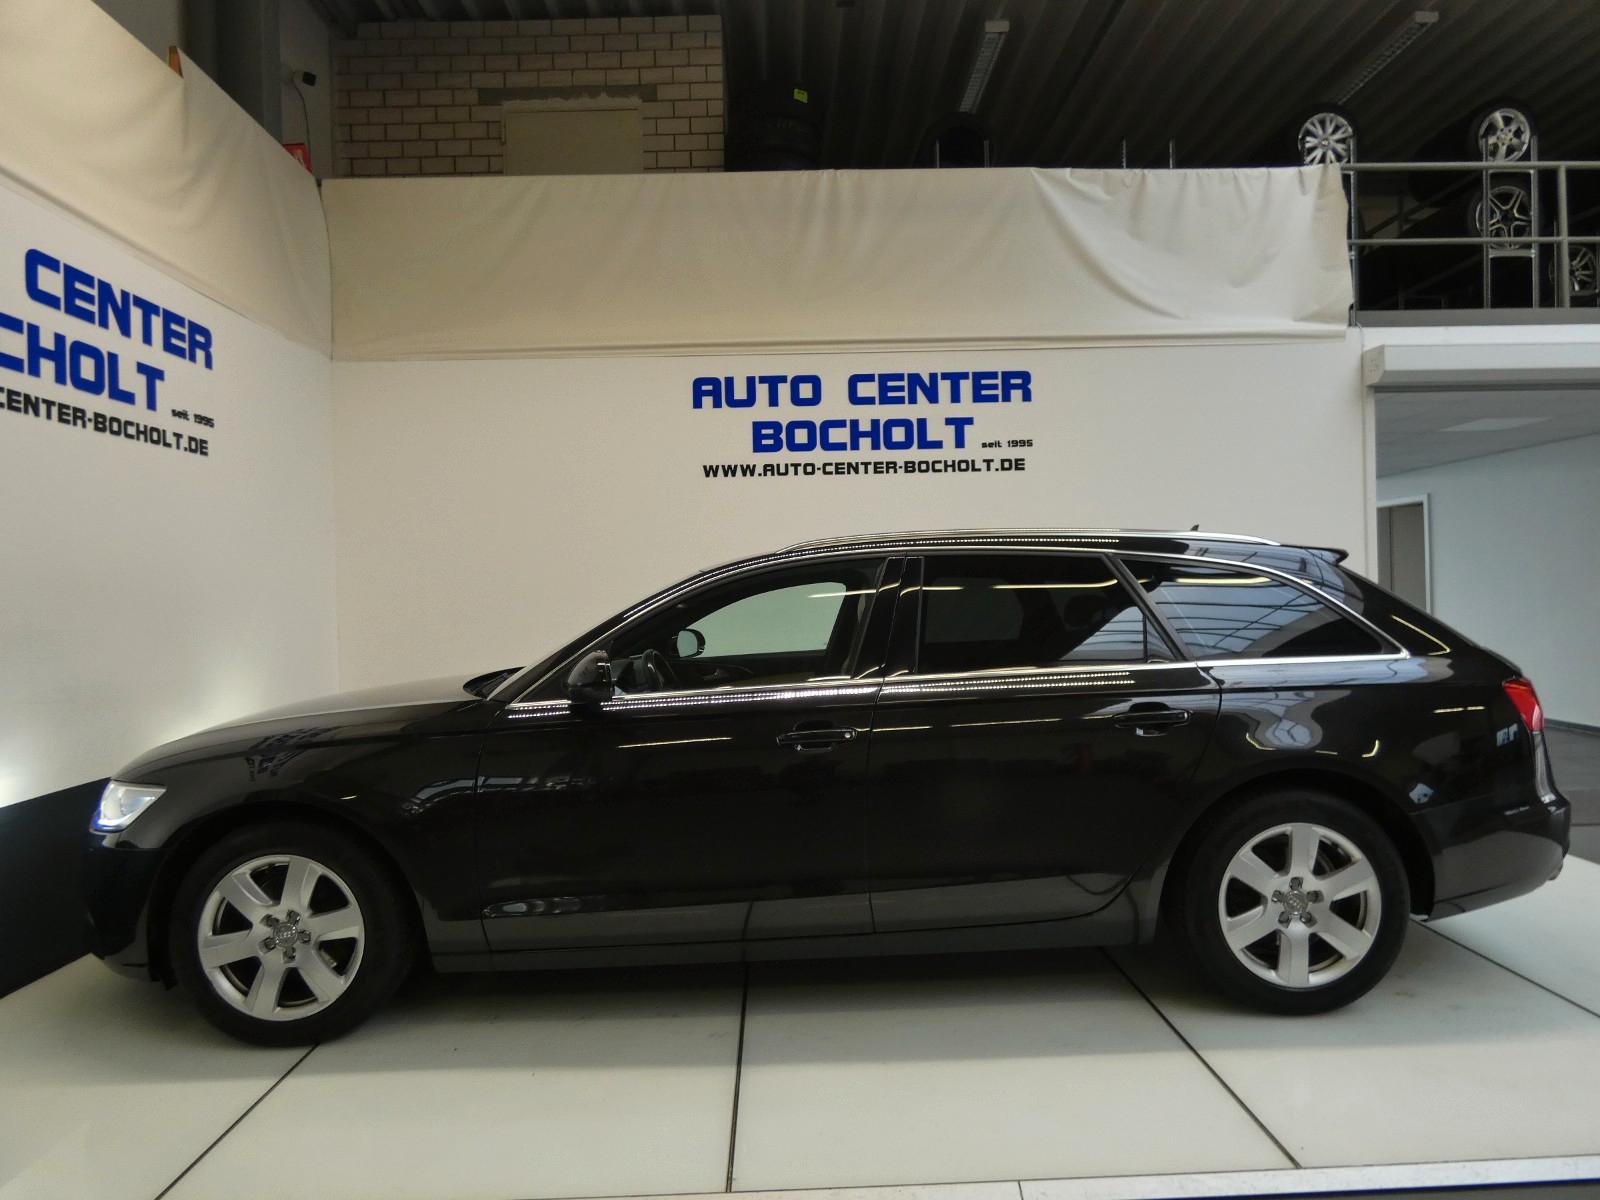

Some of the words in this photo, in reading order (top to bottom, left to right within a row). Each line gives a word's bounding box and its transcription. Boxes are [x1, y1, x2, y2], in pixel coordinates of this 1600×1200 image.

[25, 248, 213, 370] CENTER
[692, 375, 823, 409] AUTO
[847, 370, 1033, 406] CENTER
[752, 416, 975, 454] BOCHOLT
[981, 440, 1003, 449] seit
[1007, 439, 1034, 448] 1995
[702, 457, 1026, 478] WWW.AUTO-CENTER-BOCHOLT.DE
